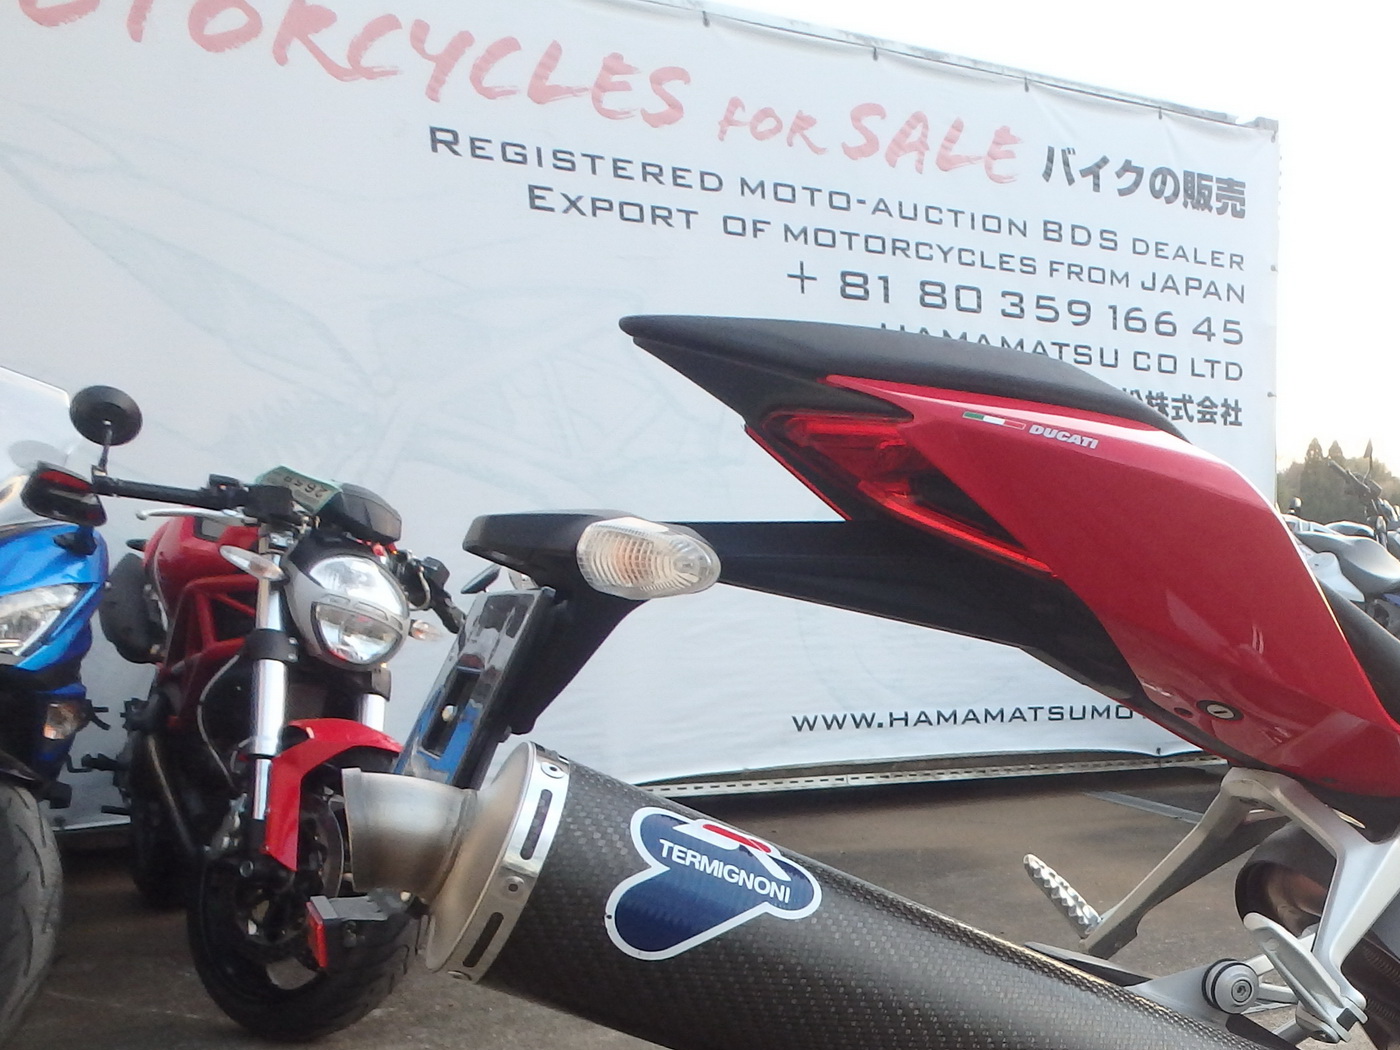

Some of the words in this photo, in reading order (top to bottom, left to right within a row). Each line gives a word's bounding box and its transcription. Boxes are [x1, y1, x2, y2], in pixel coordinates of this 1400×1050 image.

[841, 102, 1025, 185] SALE
[429, 125, 723, 193] REGISTERED
[740, 176, 1028, 238] MOTO-AUCTION
[1043, 219, 1118, 251] BDS
[1132, 237, 1245, 271] DEALER
[1041, 145, 1246, 219] バイクの販売
[528, 184, 699, 229] EXPORT
[722, 215, 771, 239] OF
[783, 223, 1037, 275] MOTORCYCLES
[1049, 260, 1129, 288] FROM
[1140, 271, 1245, 304] JAPAN
[839, 270, 890, 304] 81
[918, 279, 982, 314] 80
[1000, 290, 1092, 326] 359
[1107, 304, 1178, 337] 166
[1191, 316, 1244, 346] 45
[1132, 351, 1177, 374] CO
[1191, 357, 1244, 381] LTD
[1028, 424, 1099, 450] DUCATI
[1121, 387, 1243, 427] 株式会社
[791, 704, 1146, 733] WWW.HAMAMATSUMO
[659, 837, 792, 904] TERMIGNONI
